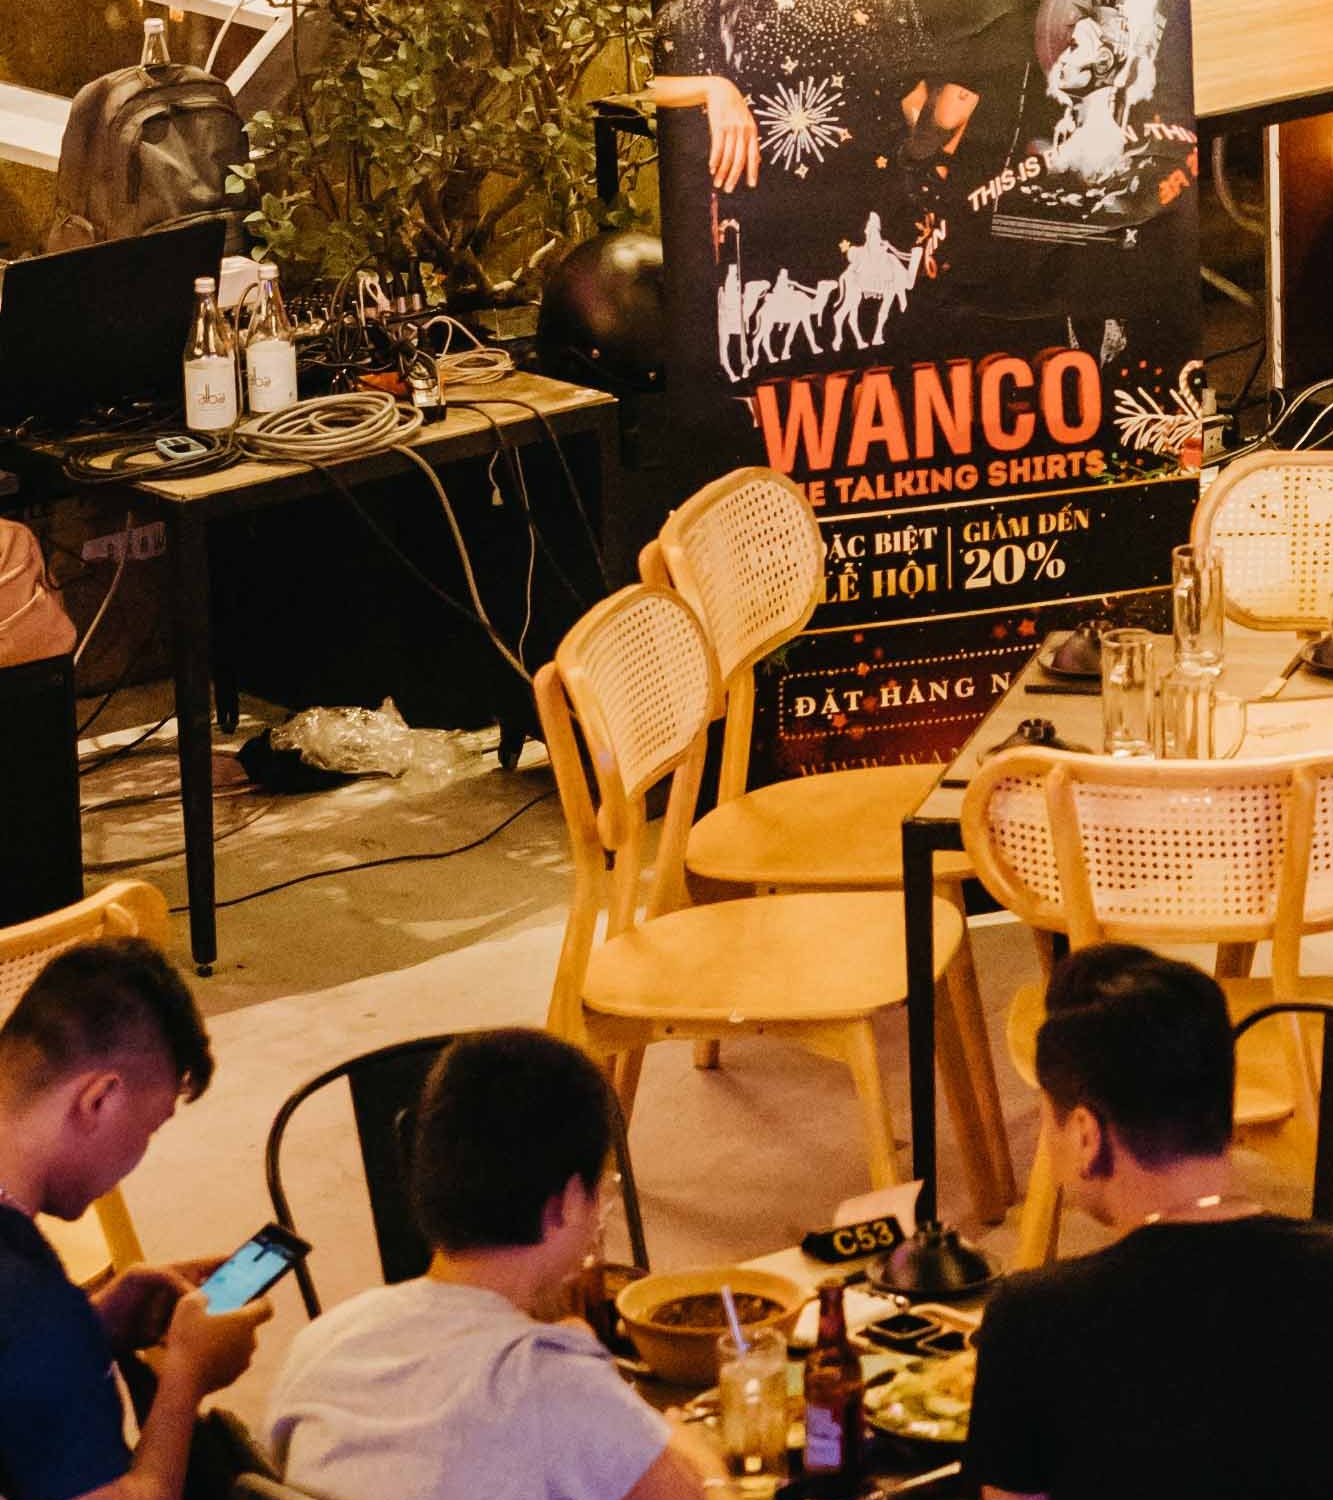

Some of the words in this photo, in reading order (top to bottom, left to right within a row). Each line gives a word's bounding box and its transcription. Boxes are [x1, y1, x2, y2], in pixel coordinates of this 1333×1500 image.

[968, 168, 1016, 212] THIS
[1017, 154, 1041, 182] IS
[756, 349, 1102, 475] WANCO
[835, 464, 978, 504] TALKING
[987, 450, 1105, 487] SHIRTS
[874, 525, 938, 557] BIỆT
[963, 513, 1030, 544] GIẢM
[872, 561, 938, 600] HỘI
[963, 539, 1067, 591] 20%
[795, 688, 863, 720] ĐẶT
[879, 677, 976, 708] HÀNG
[833, 1221, 895, 1256] C53
